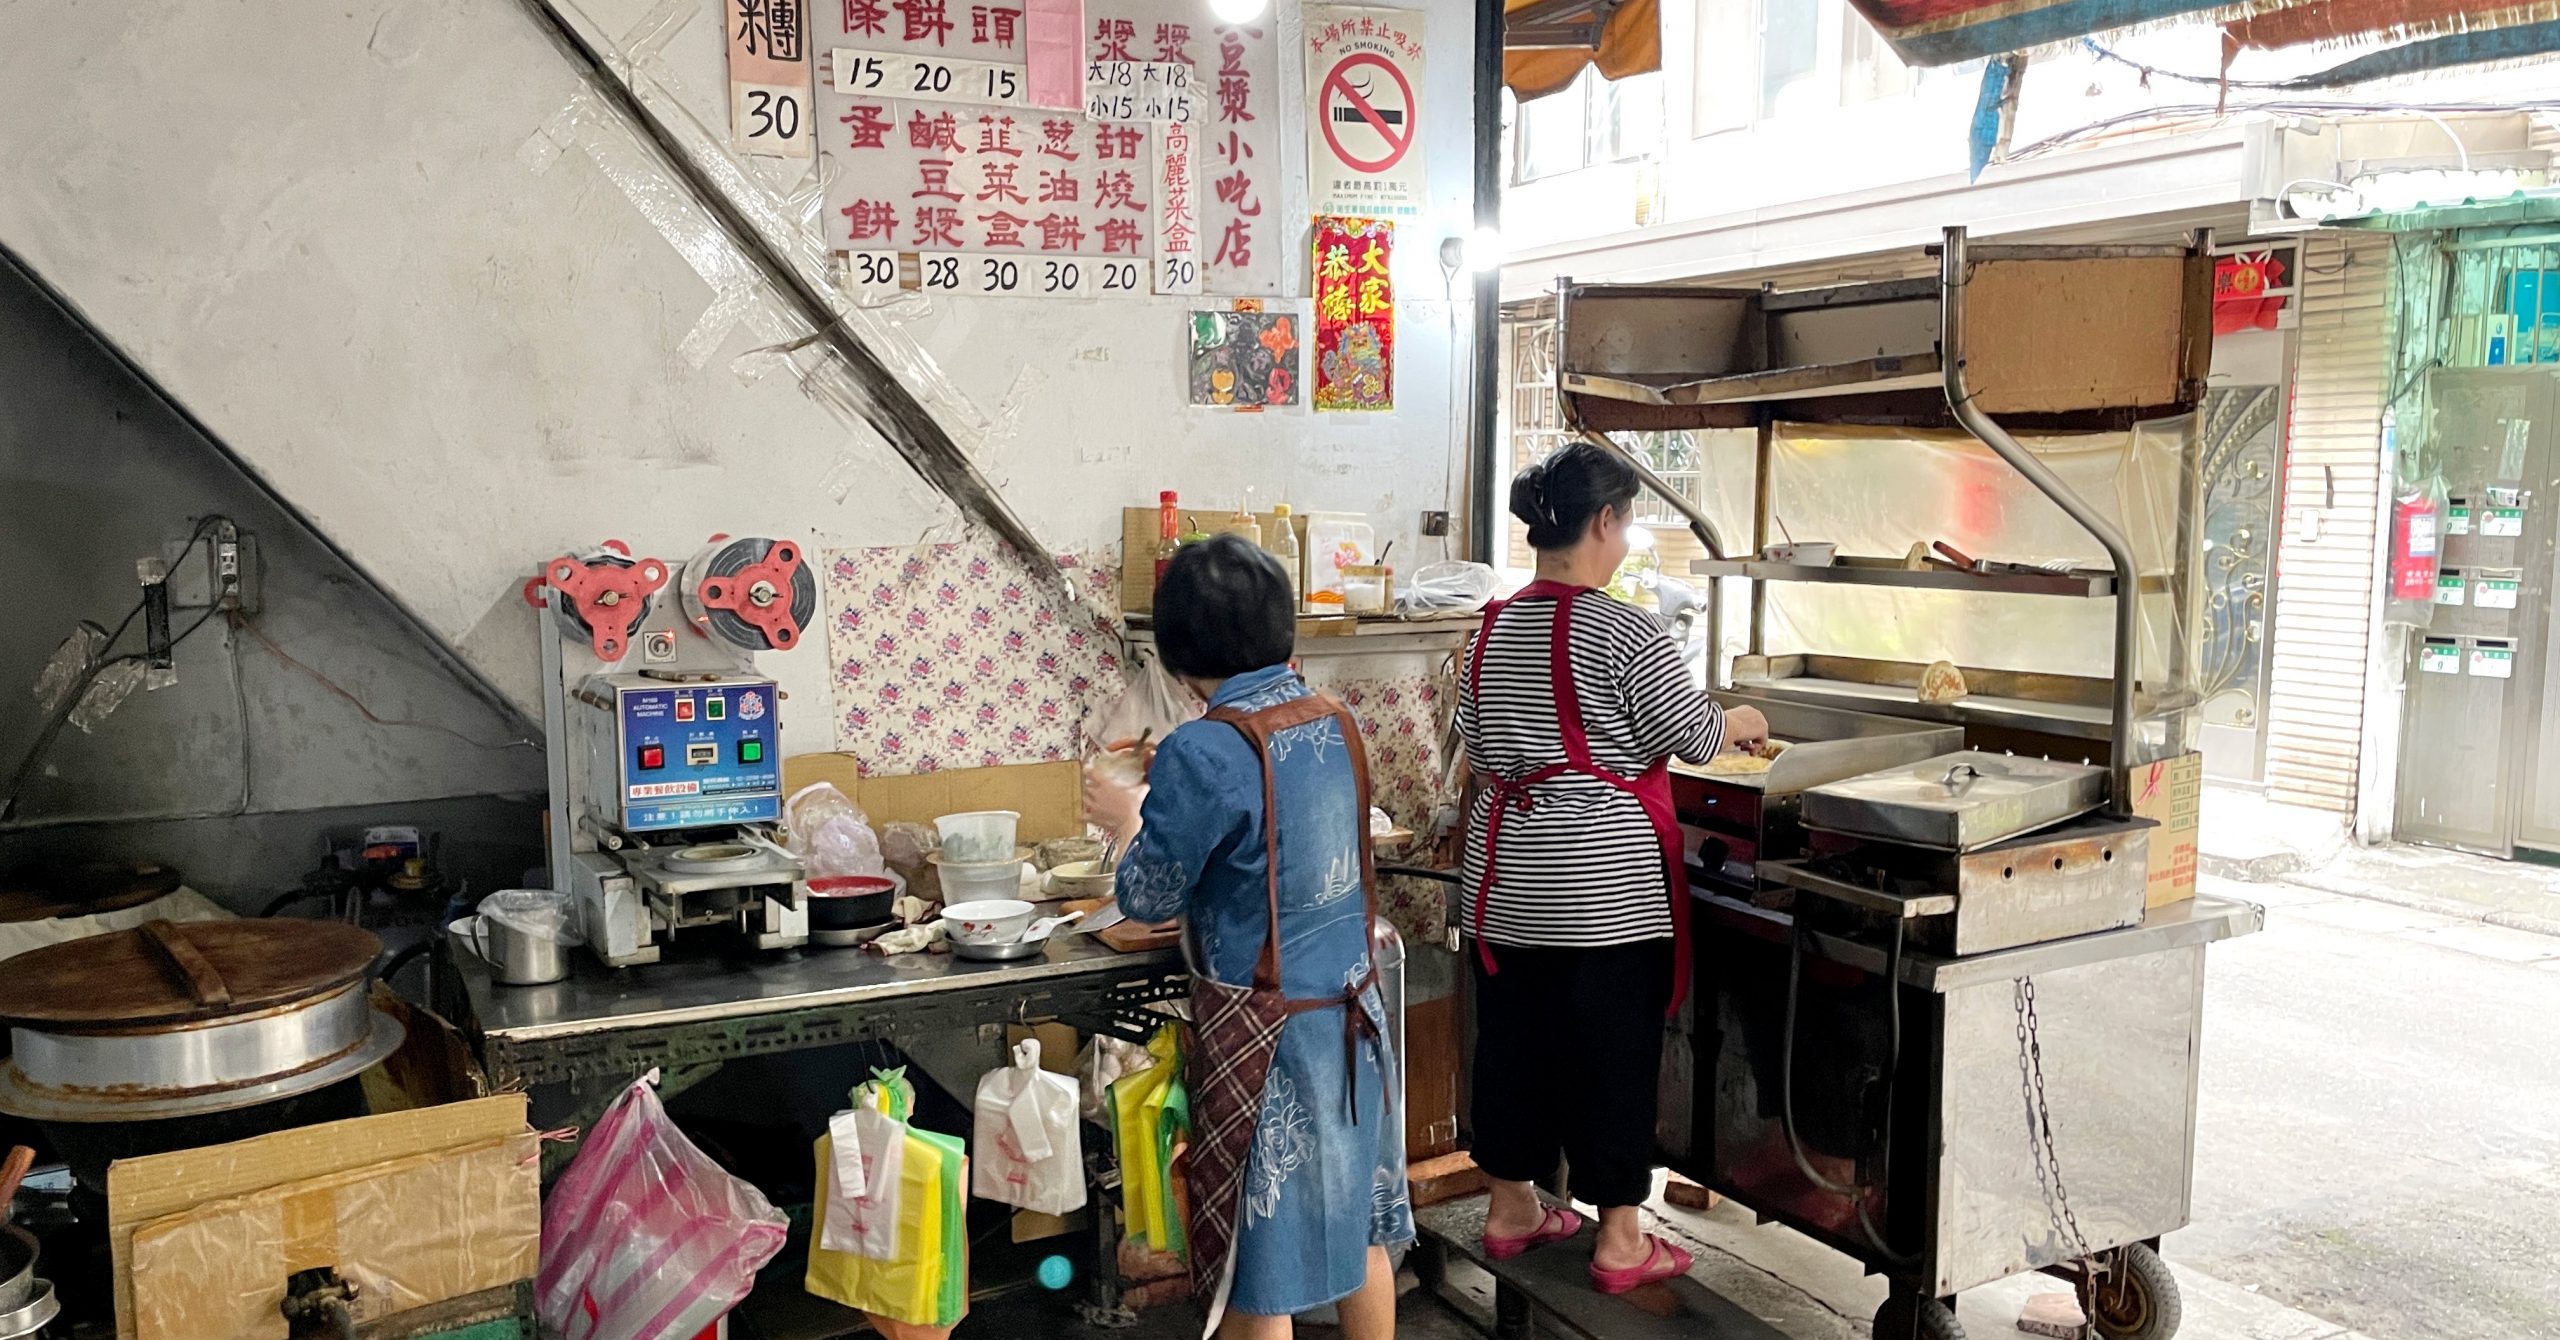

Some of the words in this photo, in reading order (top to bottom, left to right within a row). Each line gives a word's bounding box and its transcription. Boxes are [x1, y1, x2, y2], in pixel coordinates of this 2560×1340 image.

[971, 5, 1021, 50] 頭
[1339, 45, 1352, 56] NO
[1354, 41, 1396, 58] SMOKING
[850, 57, 885, 88] 15
[914, 63, 951, 93] 20
[988, 69, 1016, 98] 15
[748, 90, 799, 139] 30
[1094, 123, 1148, 255] 甜燒餅
[1161, 121, 1196, 253] 高麗菜盒
[857, 253, 894, 284] 30
[926, 256, 959, 290] 28
[983, 258, 1018, 291] 30
[1045, 261, 1080, 293] 30
[1102, 264, 1137, 291] 20
[1166, 258, 1194, 289] 30
[1358, 239, 1391, 315] 大家
